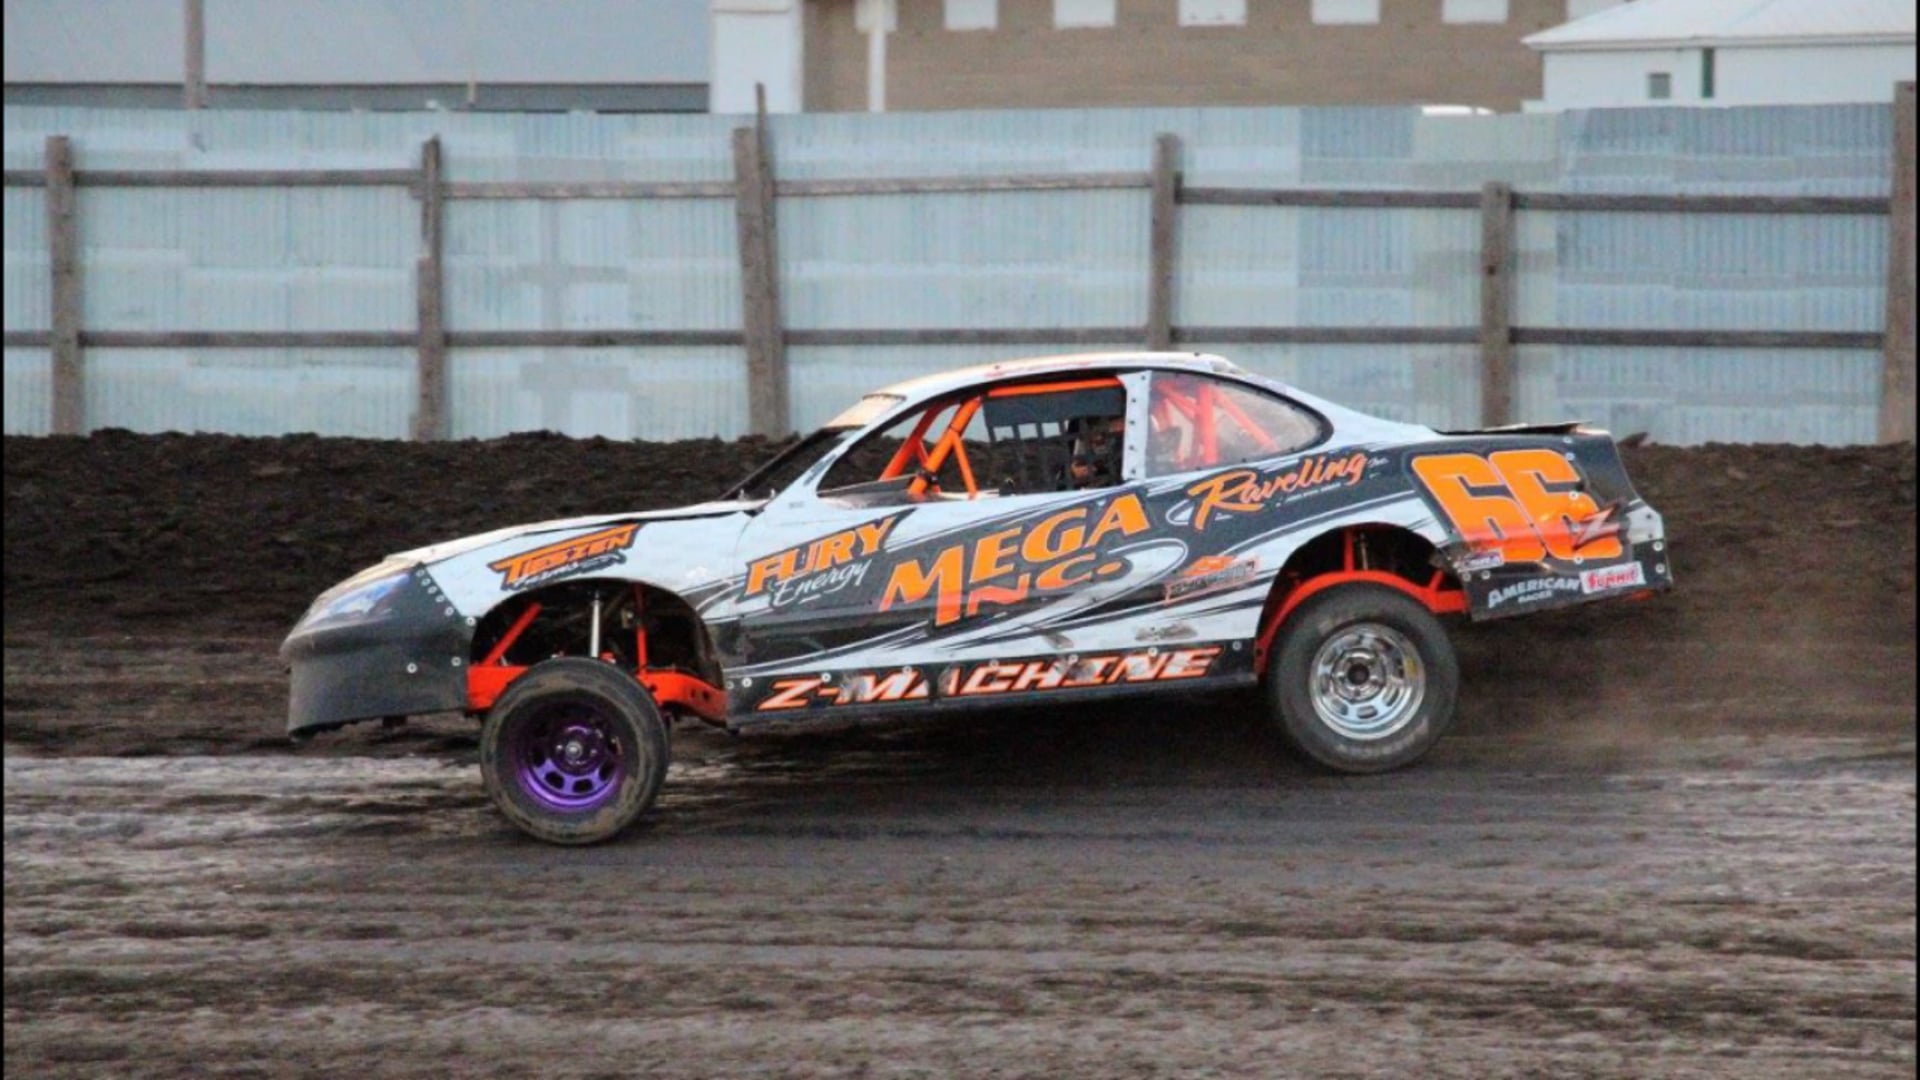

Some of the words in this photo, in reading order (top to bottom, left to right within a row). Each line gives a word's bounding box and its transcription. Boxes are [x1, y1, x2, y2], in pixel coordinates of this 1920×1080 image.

[1187, 453, 1368, 530] Raveling
[1411, 449, 1623, 562] 66
[744, 516, 898, 596] FURY
[773, 558, 873, 606] Energy
[879, 493, 1150, 626] MEGA
[1487, 577, 1581, 608] AMERICAN
